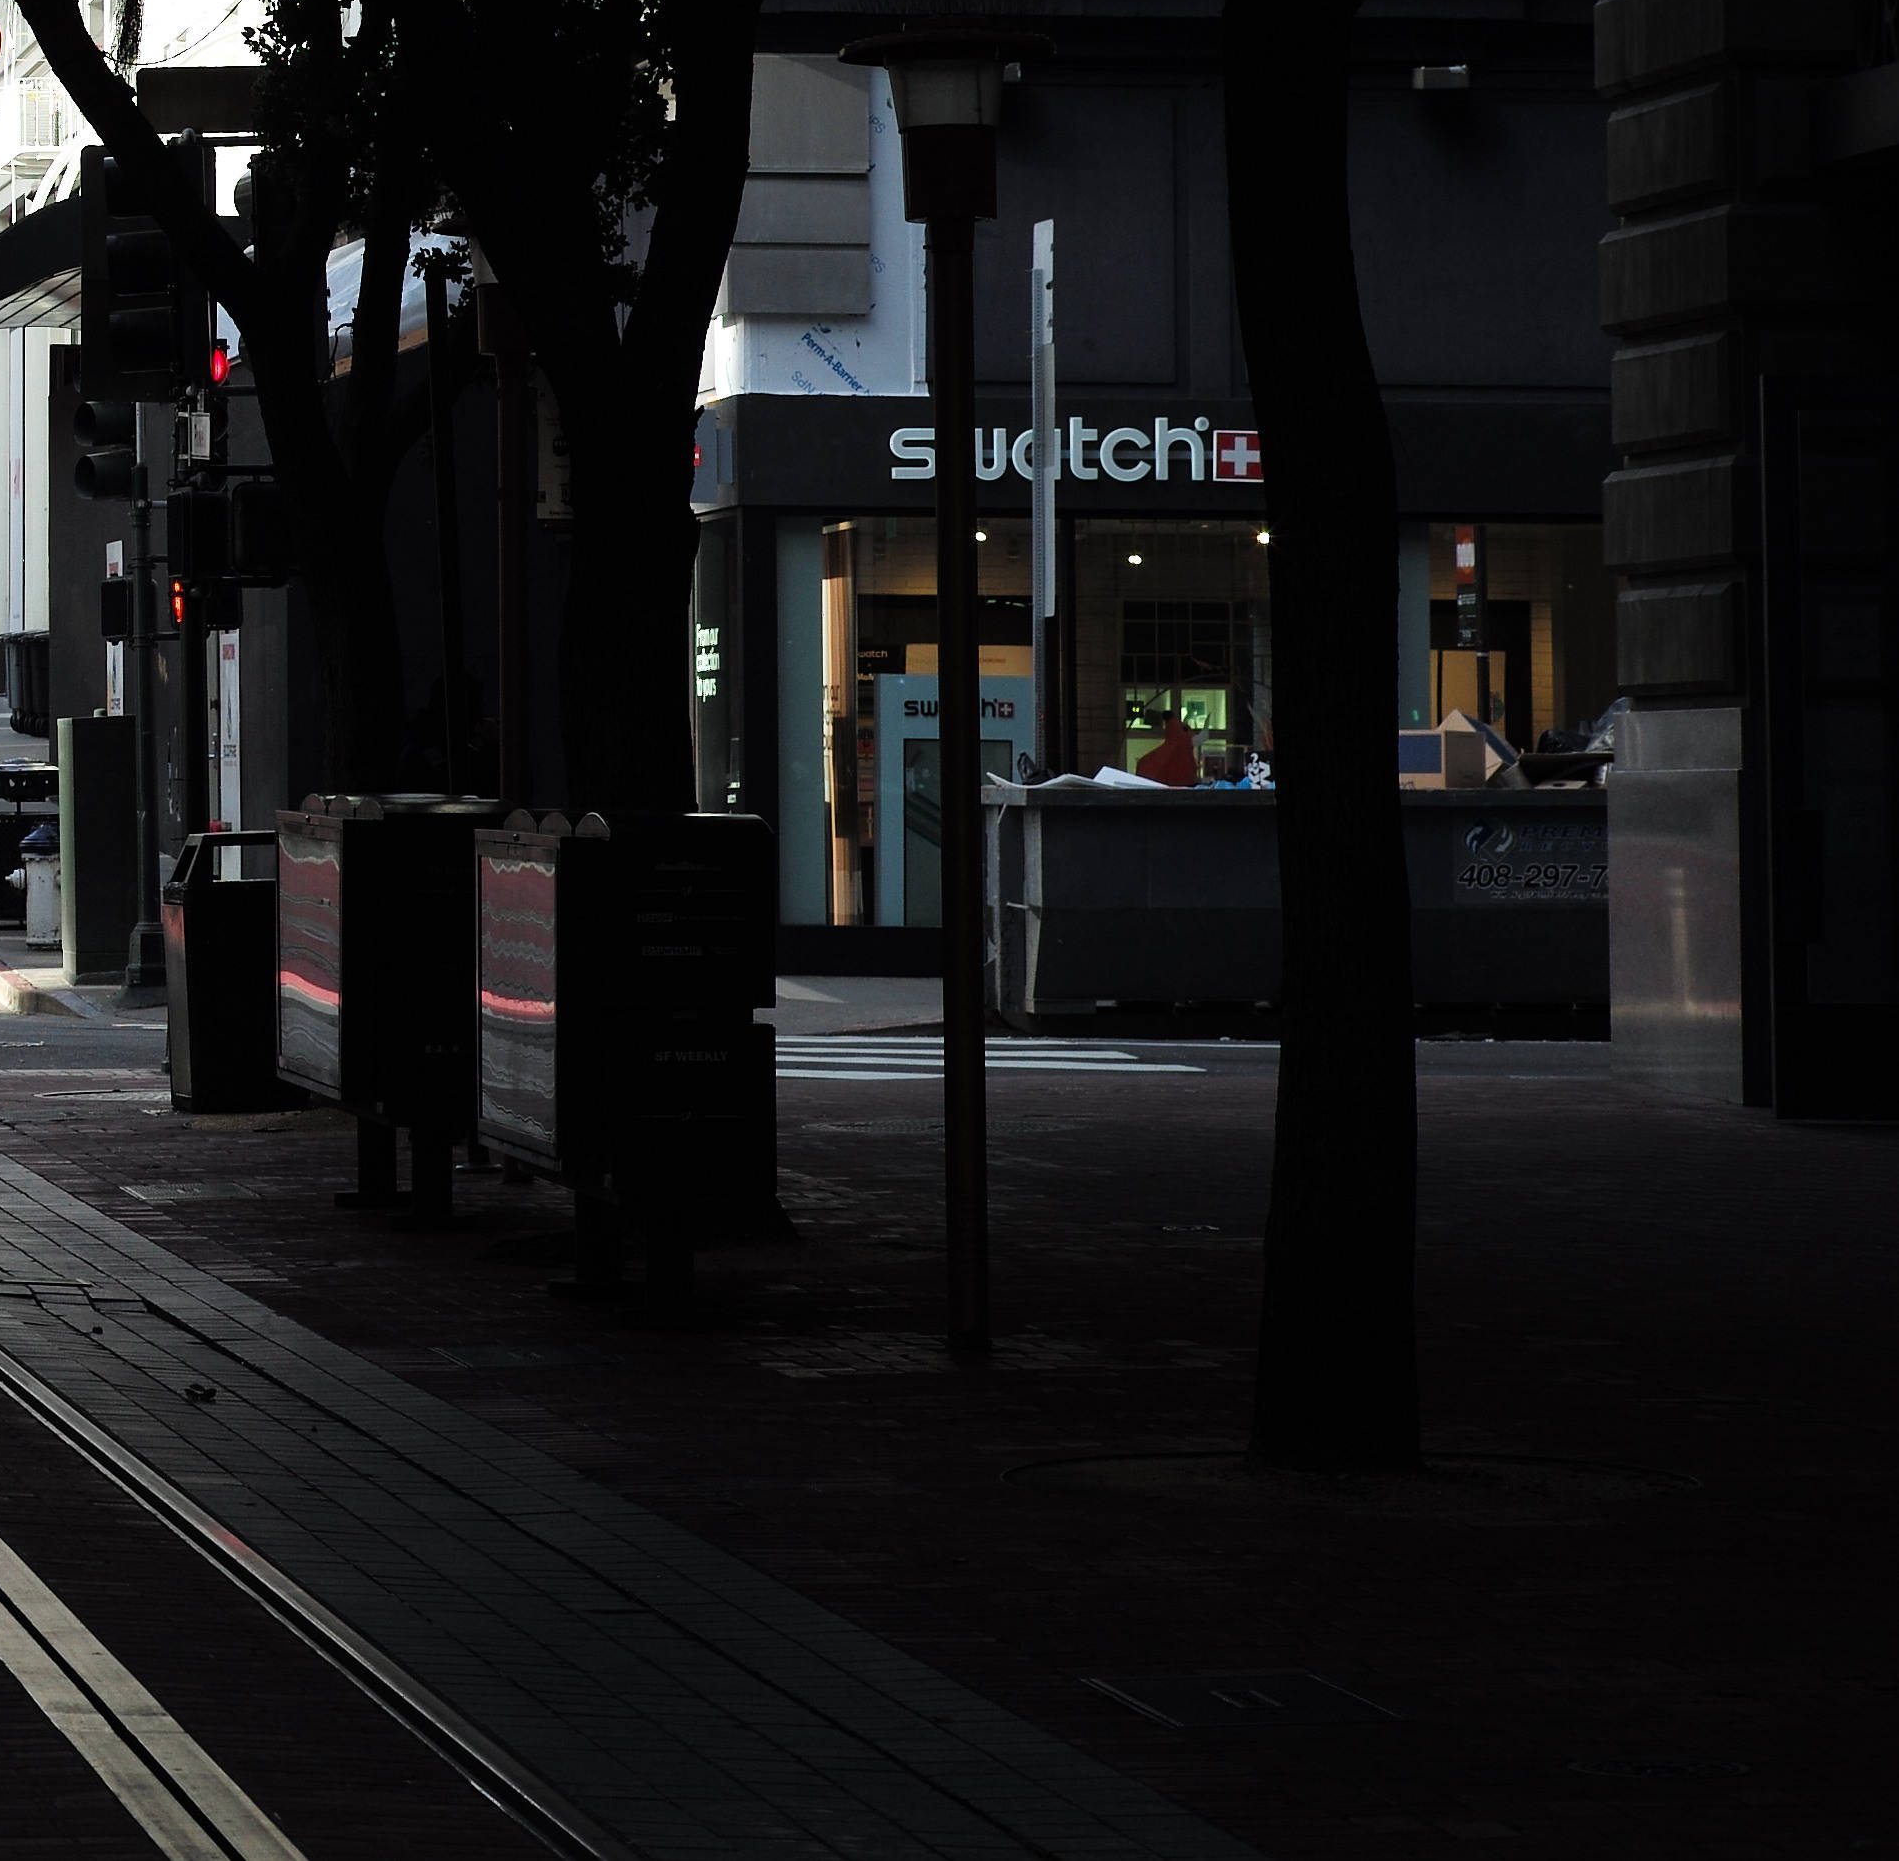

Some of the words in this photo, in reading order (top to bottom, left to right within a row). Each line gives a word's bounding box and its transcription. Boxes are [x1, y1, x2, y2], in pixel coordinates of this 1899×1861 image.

[801, 333, 864, 391] Perm-A-Barrier
[1521, 825, 1607, 838] PREM
[1458, 863, 1608, 889] 408-297-7
[654, 1049, 673, 1062] SF
[675, 1049, 729, 1062] WEEKLY
